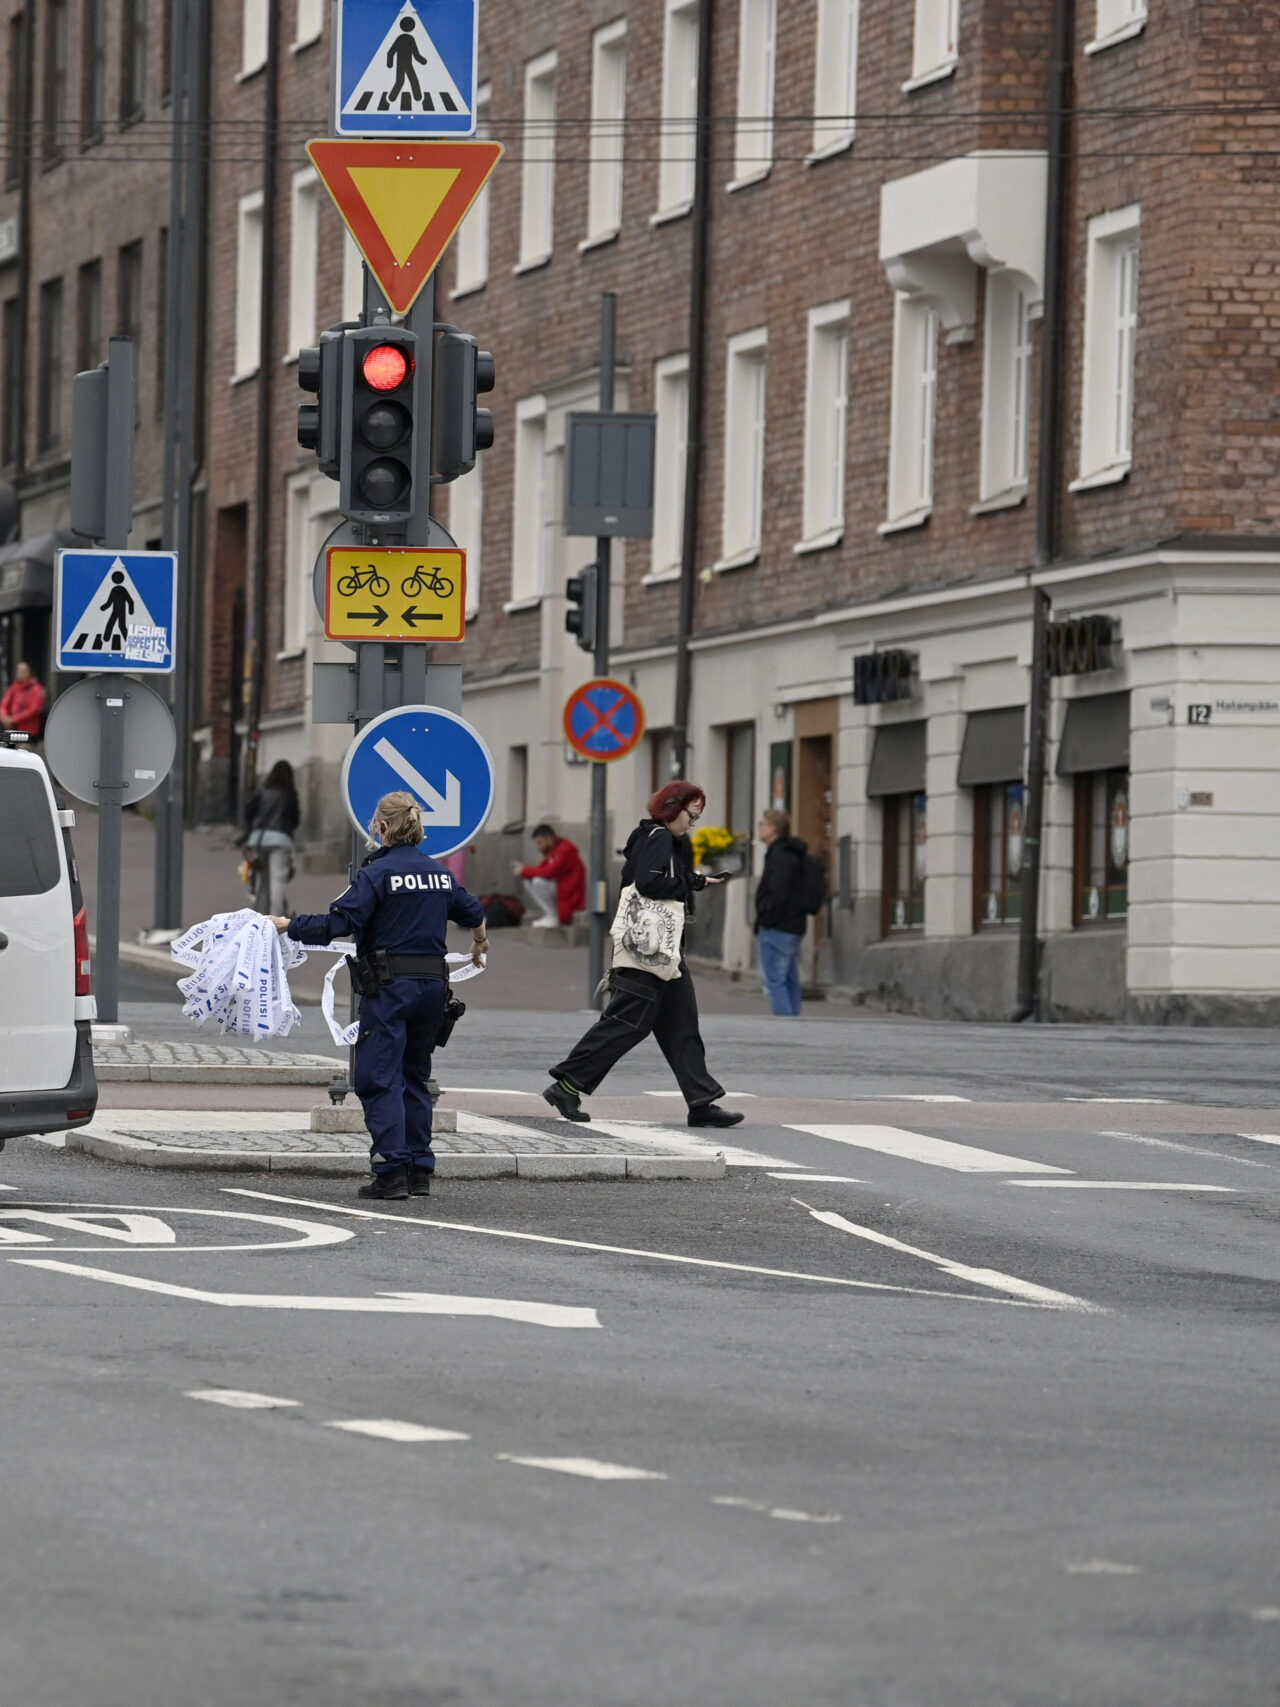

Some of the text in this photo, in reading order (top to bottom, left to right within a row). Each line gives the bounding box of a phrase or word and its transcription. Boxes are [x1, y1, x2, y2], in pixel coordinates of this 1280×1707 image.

[1191, 706, 1208, 722] 12
[1216, 700, 1279, 712] Hatanpään
[390, 874, 452, 891] POLIISI
[260, 979, 268, 1018] POLIISI
